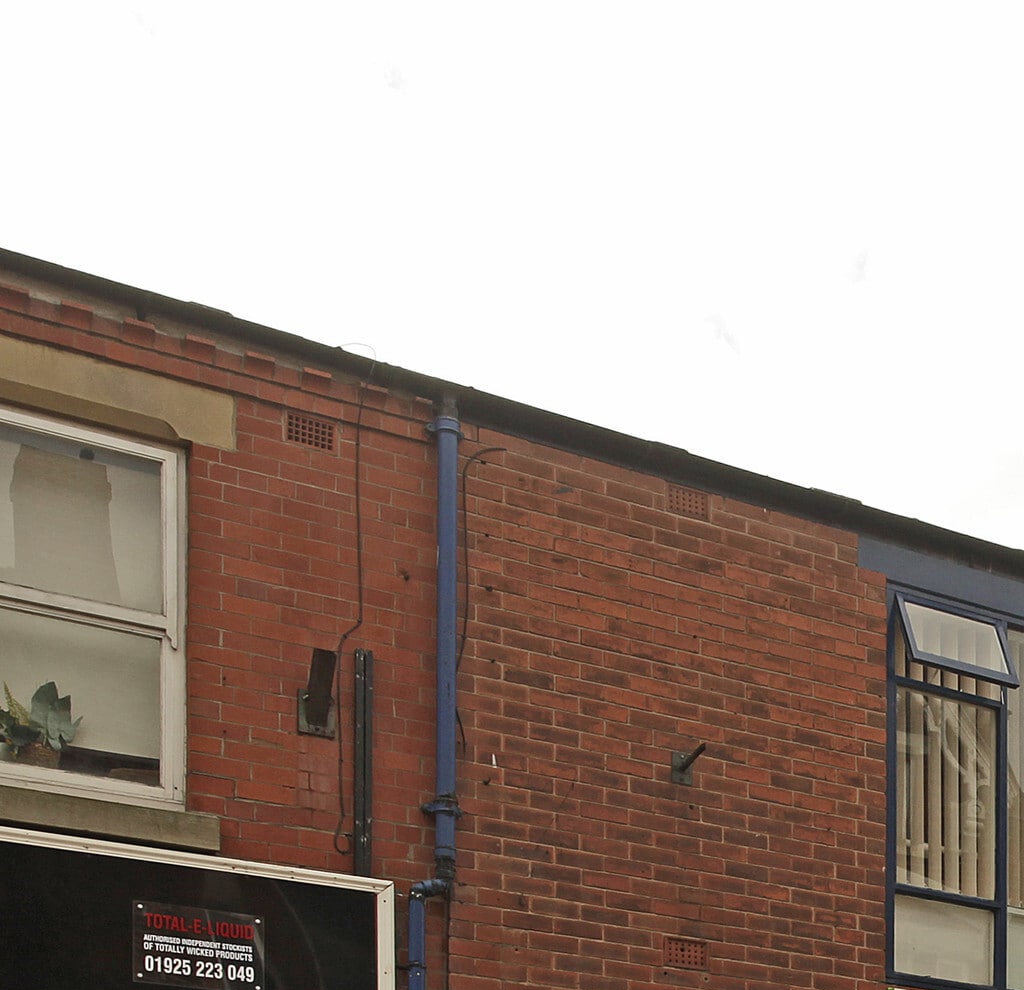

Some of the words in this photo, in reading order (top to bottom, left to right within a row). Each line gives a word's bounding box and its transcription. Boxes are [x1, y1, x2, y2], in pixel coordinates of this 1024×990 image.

[144, 912, 255, 940] TOTAL-E-LIQUID
[143, 934, 181, 945] AUTHORISED
[181, 938, 221, 949] INDEPENDENT
[222, 943, 253, 953] STOCKISTS
[143, 941, 154, 950] OF
[155, 943, 185, 954] TOTALLY
[186, 947, 215, 957] WICKED
[216, 951, 253, 962] PRODUCTS
[144, 955, 191, 976] 01925
[195, 961, 223, 980] 223
[227, 964, 255, 983] 049
